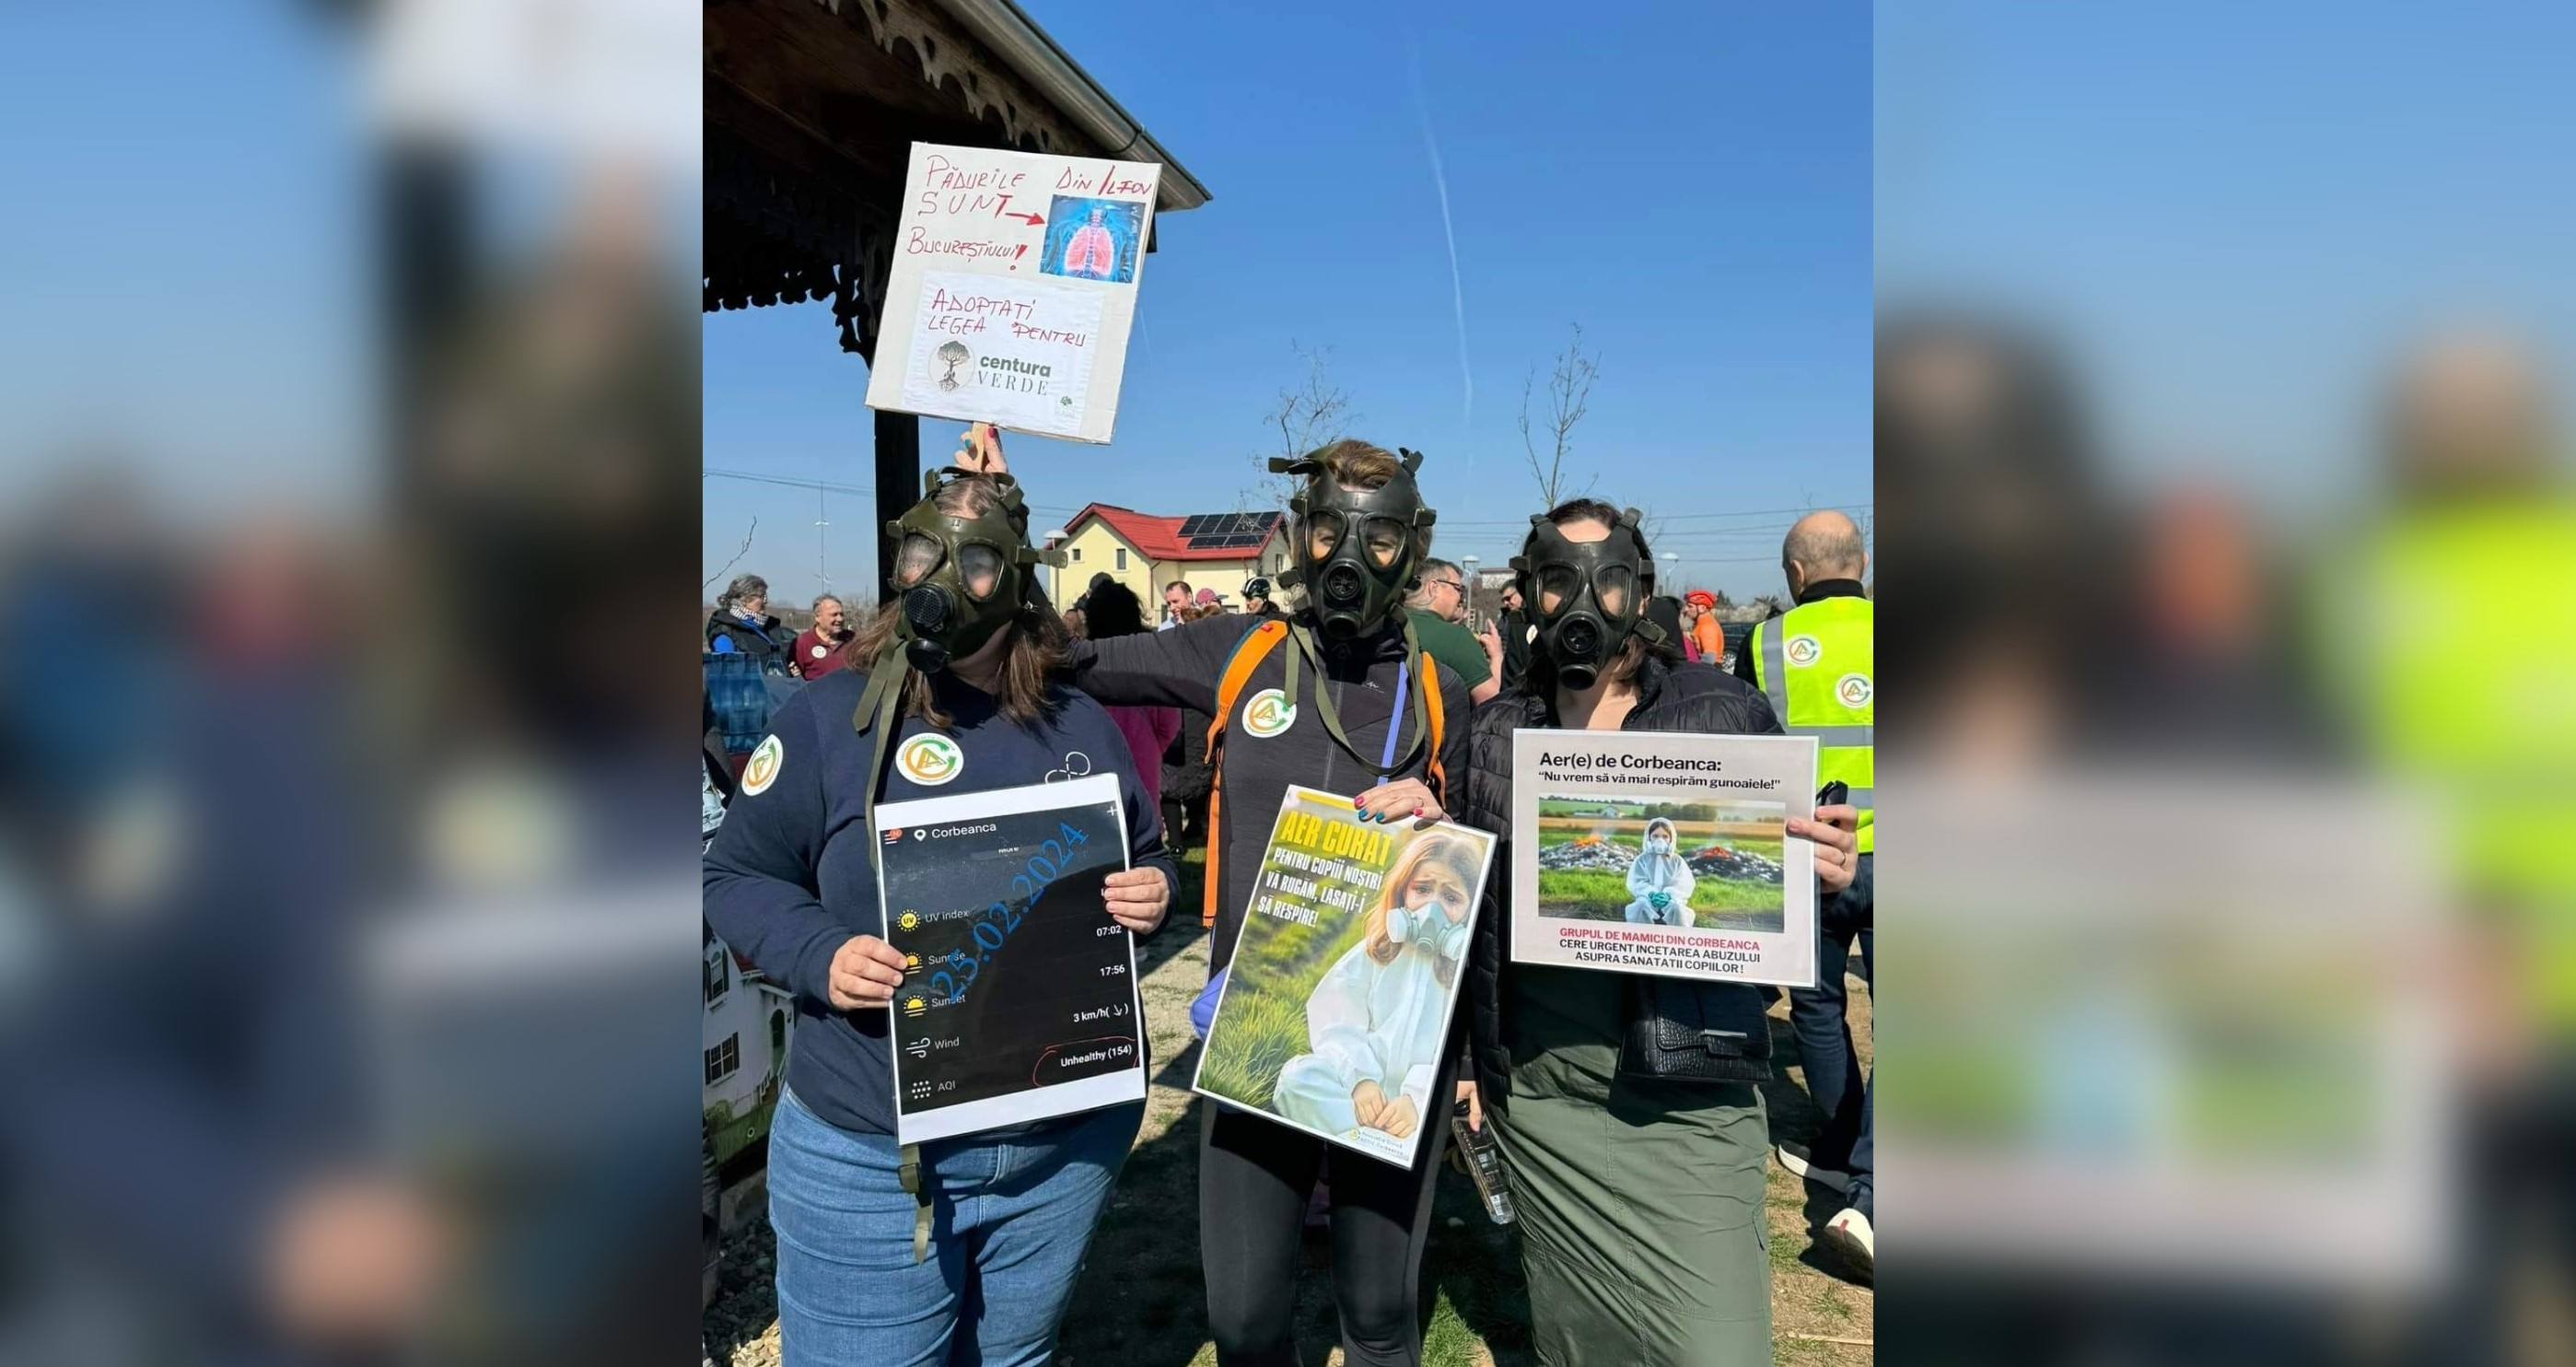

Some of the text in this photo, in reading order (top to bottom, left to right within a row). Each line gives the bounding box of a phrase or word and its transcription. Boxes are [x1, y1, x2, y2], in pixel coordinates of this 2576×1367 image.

[917, 191, 1013, 218] SUNT
[927, 315, 1086, 347] LEGEA PENTRU
[979, 356, 1052, 378] centura
[977, 370, 1049, 396] VERDE
[1539, 752, 1722, 772] Aer(e) de Corbeanca:
[1563, 773, 1593, 782] vrem
[1595, 773, 1609, 783] să
[1612, 774, 1626, 784] vă
[1627, 774, 1650, 785] mai
[1652, 776, 1708, 788] respirăm
[931, 823, 997, 839] Corbeanca
[1280, 810, 1394, 866] AER CURAT
[1273, 847, 1311, 871] PENTRU
[1265, 870, 1282, 889] VĂ
[930, 821, 1090, 1005] 25.02.2024
[1257, 894, 1275, 915] SĂ
[903, 916, 915, 925] UV
[925, 909, 970, 923] UV index
[1096, 925, 1123, 937] 07:02
[1559, 927, 1761, 951] GRUPUL DE MAMICI DIN CORBEANCA
[928, 952, 966, 965] Sunrse
[1559, 939, 1761, 964] CERE URGENT INCETAREA ABUZULUI
[1100, 964, 1125, 976] 17:56
[1575, 951, 1621, 964] ASUPRA
[1622, 954, 1684, 969] SANATATII
[1684, 960, 1739, 974] COPIILOR
[1073, 1013, 1079, 1022] 3
[934, 1036, 960, 1050] Wind
[1060, 1044, 1133, 1068] Unhealthy (154)
[938, 1080, 956, 1092] AQI
